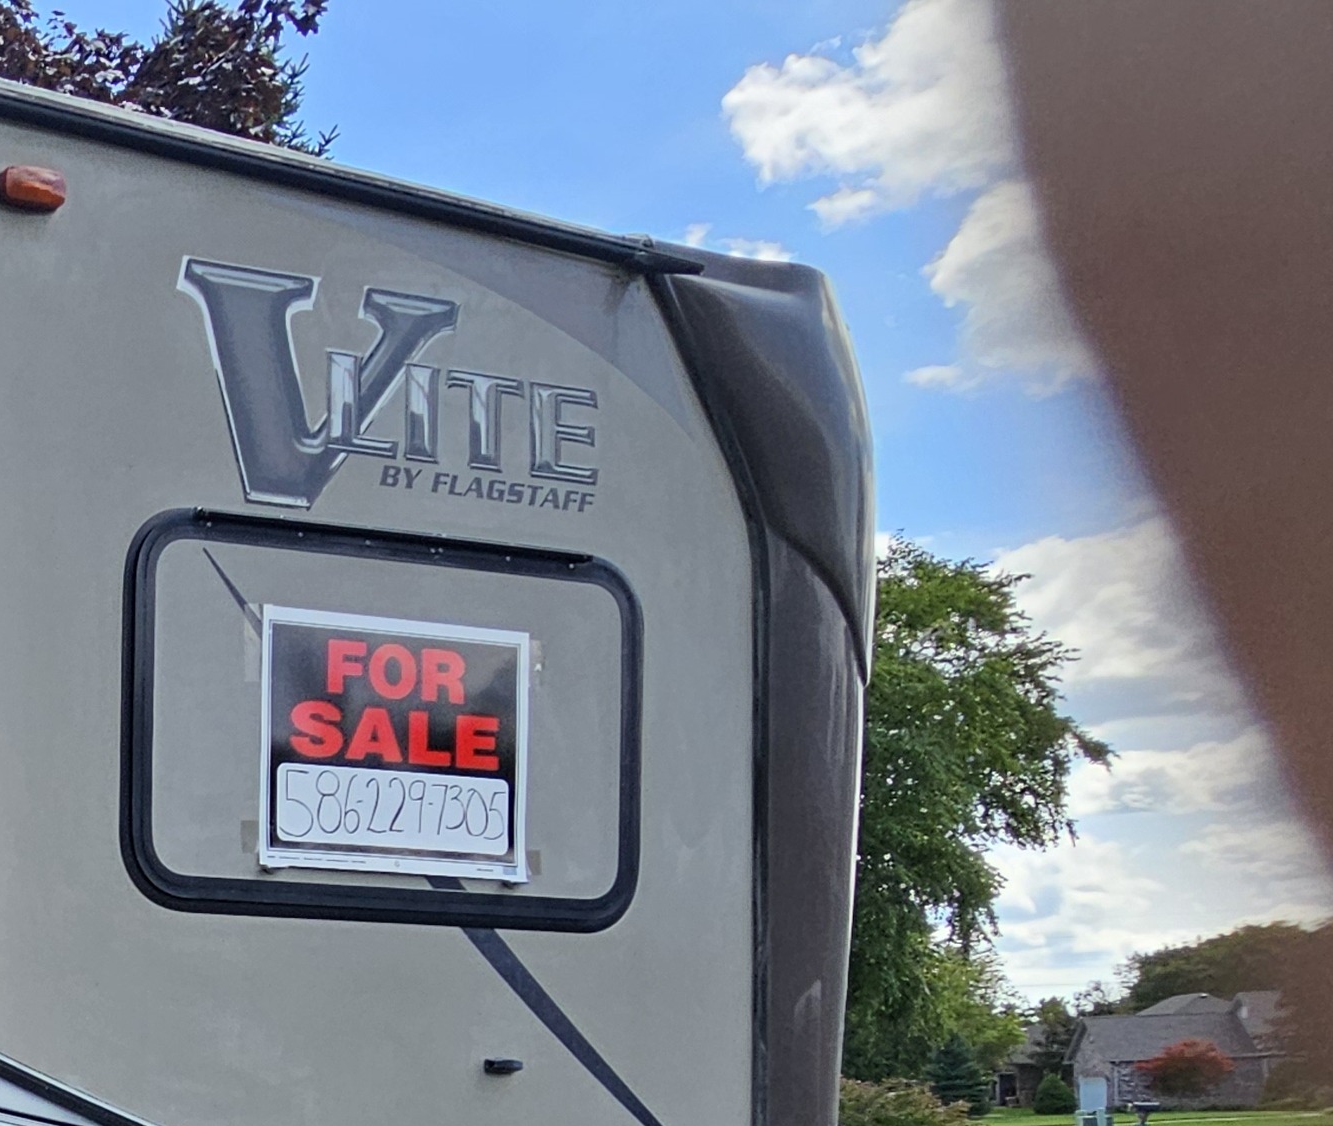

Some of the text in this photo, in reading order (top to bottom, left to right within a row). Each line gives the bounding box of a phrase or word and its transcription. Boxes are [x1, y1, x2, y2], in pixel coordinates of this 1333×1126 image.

[379, 464, 596, 513] BY FLAGSTAFF
[326, 638, 466, 705] FOR
[289, 699, 501, 771] SALE
[278, 769, 507, 841] 586-229-7305
